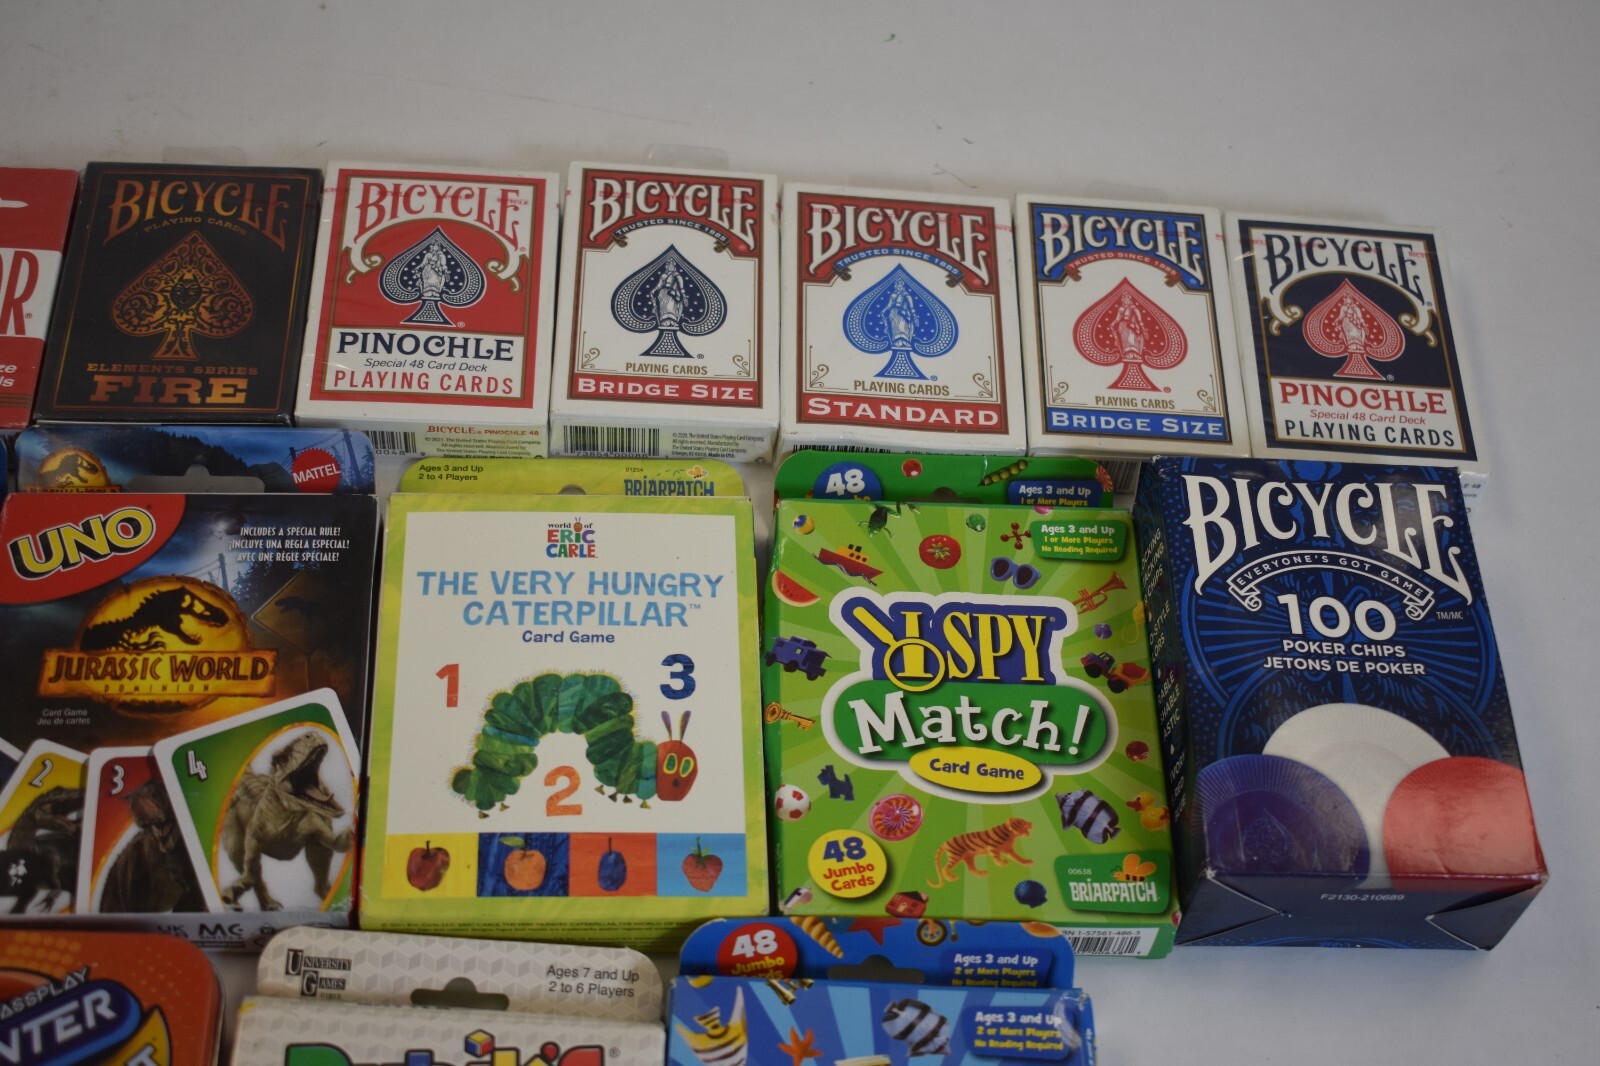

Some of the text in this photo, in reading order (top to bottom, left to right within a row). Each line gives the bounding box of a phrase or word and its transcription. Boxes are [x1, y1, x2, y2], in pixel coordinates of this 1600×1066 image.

[103, 179, 290, 252] BICYCLE
[354, 182, 519, 252] BICYCLE
[589, 178, 755, 250] BICYCLE
[144, 217, 247, 235] PLAYING CARDS
[616, 218, 727, 242] TRUSTED SINCE 1885
[807, 203, 990, 286] BICYCLE
[1039, 212, 1204, 285] BICYCLE
[837, 248, 959, 276] TRUSTED SINCE 1885
[1069, 252, 1115, 269] TRUSTED
[1118, 252, 1151, 264] SINCE
[1263, 233, 1425, 306] BICYCLE
[337, 332, 513, 362] PINOCHLE
[87, 363, 258, 375] ELEMENTS SERIES
[364, 358, 488, 373] Special 48 Card Deck
[626, 362, 708, 376] PLAYING CARDS
[90, 375, 248, 404] FIRE
[334, 370, 513, 395] PLAYING CARDS
[578, 378, 680, 397] BRIDGE
[854, 380, 950, 396] PLAYING CARDS
[1095, 395, 1175, 410] PLAYING CARDS
[1280, 382, 1447, 415] PINOCHLE
[808, 397, 999, 426] STANDARD
[1052, 411, 1151, 432] BRIDGE
[1310, 409, 1426, 425] Special 48 Card Deck
[426, 426, 474, 434] BICYCLE
[1285, 419, 1455, 447] PLAYING CARDS
[293, 462, 340, 484] MATTEL
[470, 465, 484, 473] Up
[826, 468, 865, 496] 48
[1018, 485, 1091, 497] Ages 3 and Up
[1058, 499, 1088, 507] Players
[240, 526, 341, 536] INCLUDES A SPECIAL RULE!
[1041, 524, 1115, 536] Ages 3 and Up
[1181, 474, 1473, 605] BICYCLE
[12, 507, 154, 577] UNO
[266, 539, 282, 549] UNA
[285, 539, 310, 549] REGLA
[312, 539, 349, 549] ESPECIAL!
[1053, 546, 1083, 555] Reading
[1085, 546, 1118, 555] Required
[1061, 536, 1081, 544] More
[1083, 536, 1113, 545] Players
[237, 551, 256, 562] AVEC
[259, 552, 276, 562] UNE
[546, 544, 596, 558] CARLE
[417, 570, 724, 598] THE VERY HUNGRY
[1237, 554, 1425, 597] EVERYONE'S GOT GAME
[463, 601, 688, 627] CATERPILLAR
[1277, 593, 1396, 640] 100
[1436, 611, 1464, 620] TM/MC
[522, 630, 615, 643] Card Game
[943, 611, 1047, 681] SPY
[1282, 639, 1406, 658] POKER CHIPS
[49, 655, 270, 684] JURASSIC WORLD
[1263, 656, 1425, 675] JETONS DE POKER
[435, 663, 460, 708] 1
[660, 653, 696, 700] 3
[104, 684, 211, 694] DOMINION
[37, 716, 91, 726] Jeu de cartes
[42, 708, 88, 717] Card Game
[848, 691, 1090, 755] Match!
[30, 758, 54, 788] 2
[186, 750, 208, 780] 4
[929, 758, 1024, 780] Card Game
[110, 764, 126, 796] 3
[543, 765, 583, 817] 2
[822, 836, 866, 863] 48
[823, 861, 875, 880] Jumbo
[831, 875, 875, 892] Cards
[1069, 878, 1158, 903] BRIARPATCH
[1320, 893, 1405, 901] F2130-210689
[732, 929, 778, 958] 48
[286, 949, 351, 975] UNIVERSITY
[731, 957, 785, 977] Jumbo
[953, 953, 1038, 968] Ages 3 and Up
[301, 970, 346, 996] GAMES
[546, 965, 640, 983] Ages 7 and Up
[952, 978, 1038, 988] No Reading Required
[955, 967, 1036, 979] 2 or More Players
[548, 980, 635, 998] 2 to 6 Players
[975, 1011, 1062, 1028] Ages 3 and Up
[977, 1027, 1061, 1040] 2 or More Players
[974, 1040, 1063, 1051] No Reading Required
